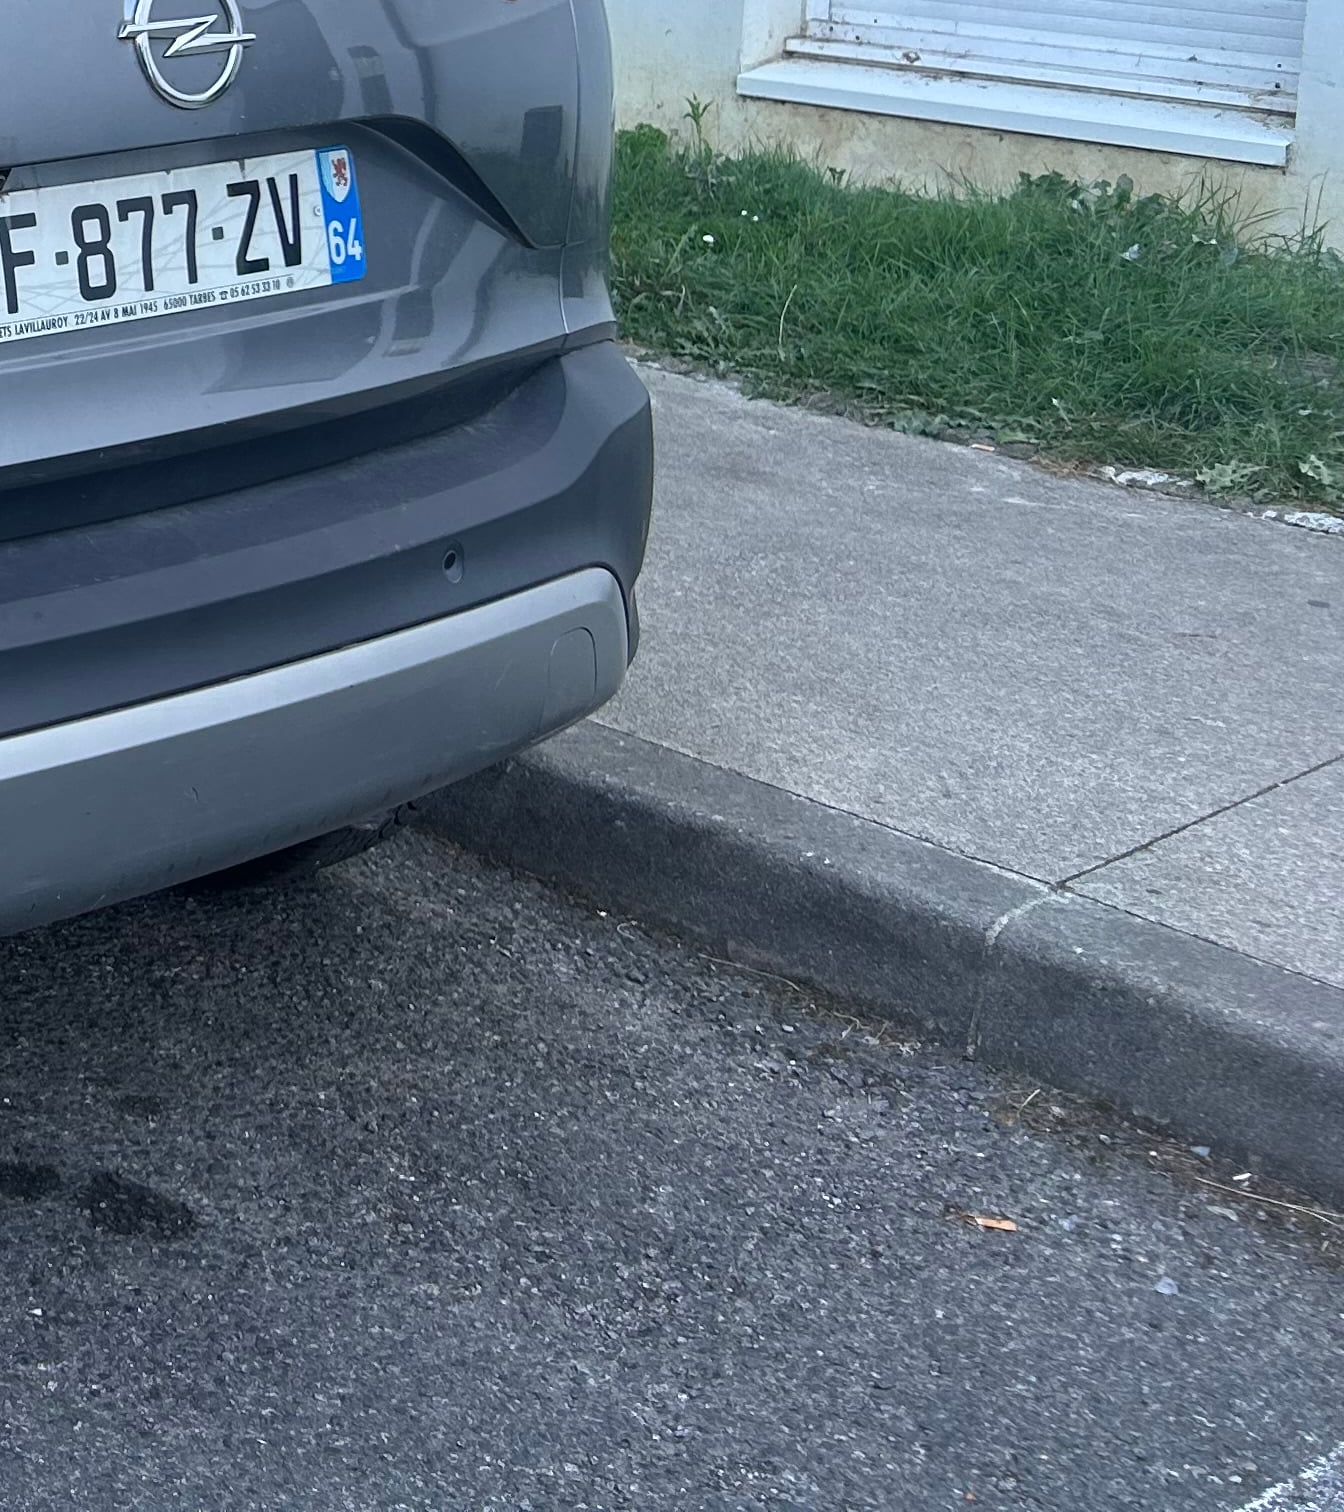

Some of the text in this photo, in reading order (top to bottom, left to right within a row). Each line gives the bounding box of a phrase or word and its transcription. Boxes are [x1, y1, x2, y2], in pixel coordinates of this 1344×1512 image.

[328, 218, 363, 265] 64
[14, 316, 69, 336] LAVILLAUROY
[74, 311, 99, 326] 22/24
[100, 308, 111, 321] AV
[113, 307, 119, 319] 8
[121, 304, 137, 318] MAI
[140, 300, 158, 315] 1945
[163, 295, 187, 311] 65000
[188, 290, 216, 306] TARBES
[229, 288, 239, 299] 05
[240, 285, 250, 296] 62
[251, 283, 260, 294] 53
[271, 279, 280, 291] 10
